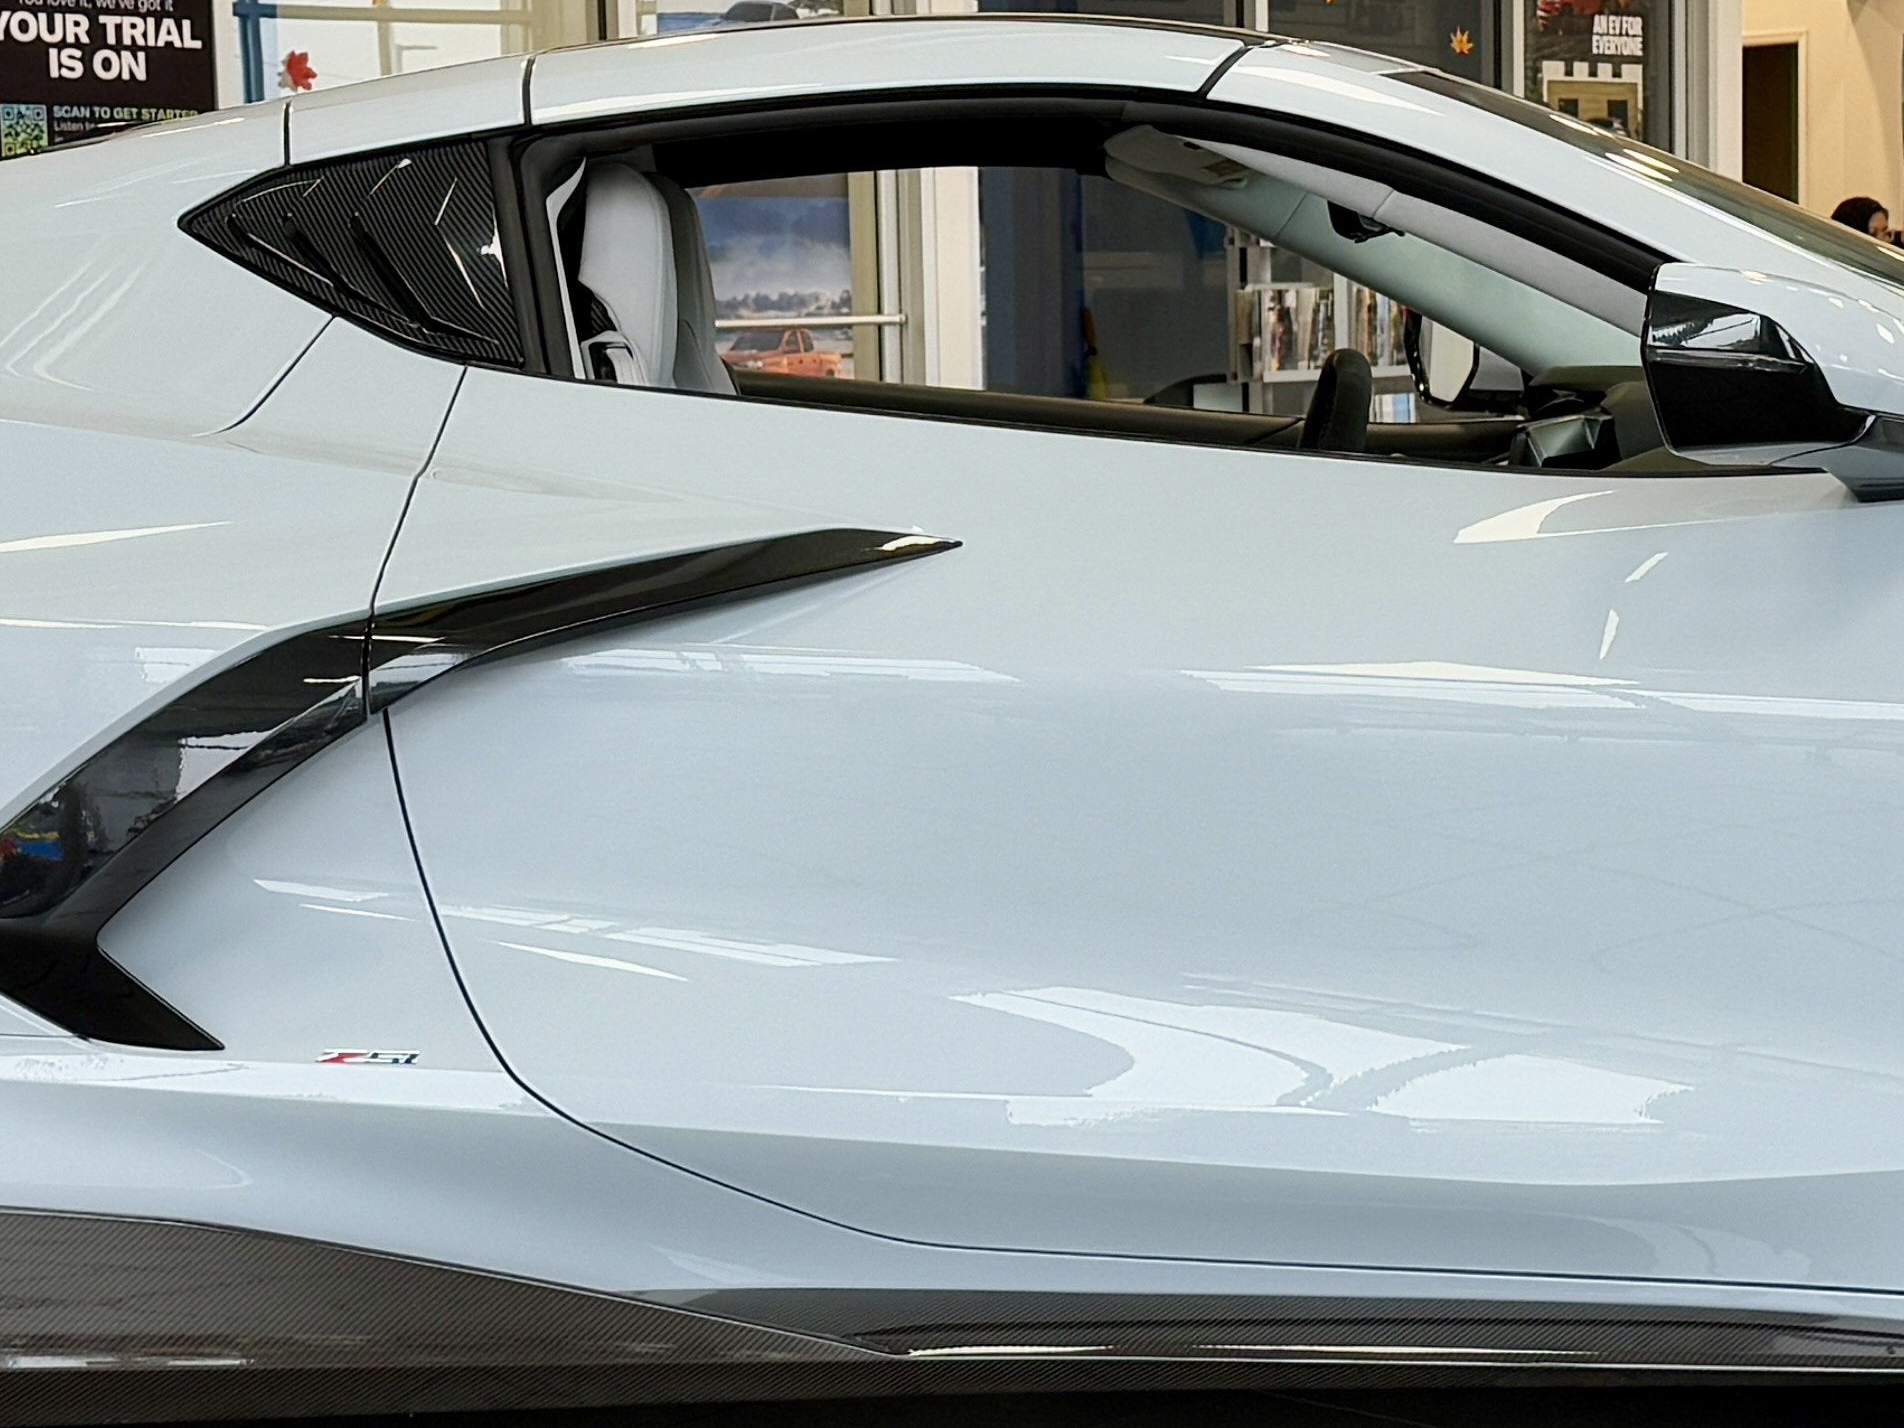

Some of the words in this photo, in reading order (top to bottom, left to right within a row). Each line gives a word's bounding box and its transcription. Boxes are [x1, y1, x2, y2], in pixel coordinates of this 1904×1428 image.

[98, 15, 203, 49] TRIAL
[1593, 14, 1608, 35] AN
[1609, 15, 1620, 35] EV
[1622, 15, 1642, 36] FOR
[1592, 35, 1644, 56] EVERYONE
[48, 47, 85, 79] IS
[92, 48, 147, 82] ON
[53, 105, 91, 119] SCAN
[92, 106, 111, 119] TO
[113, 107, 138, 120] GET
